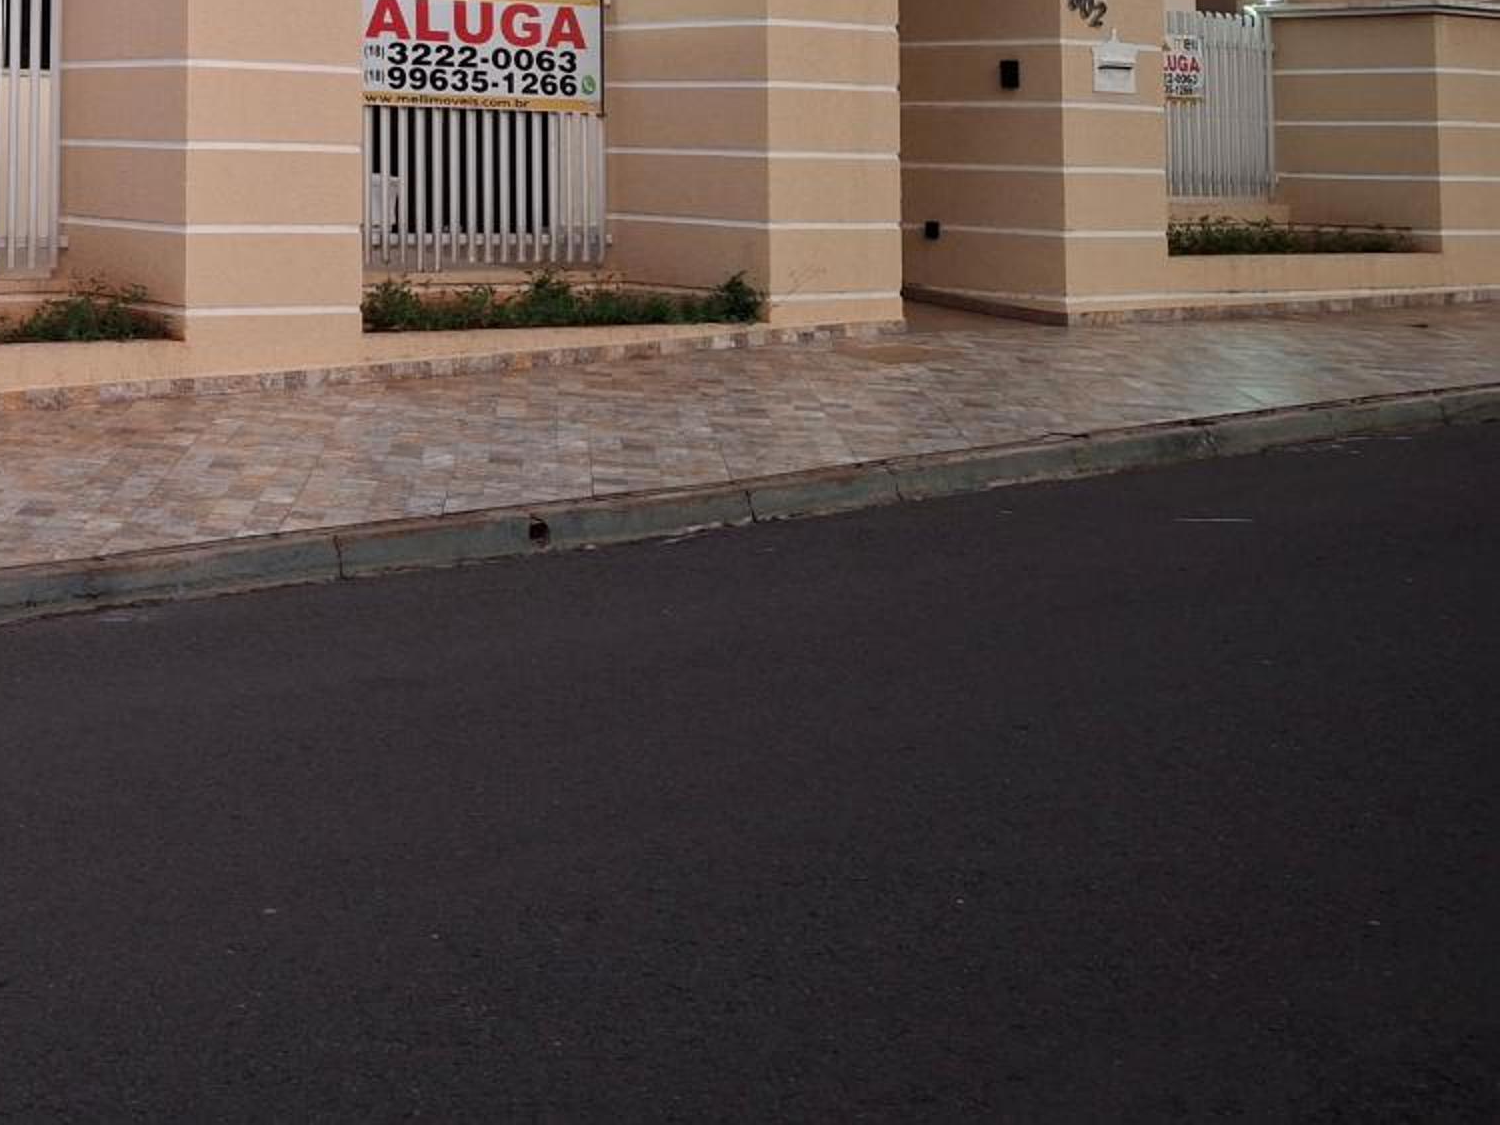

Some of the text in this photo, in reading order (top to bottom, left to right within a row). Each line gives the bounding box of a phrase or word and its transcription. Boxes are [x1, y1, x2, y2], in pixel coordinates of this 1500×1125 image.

[387, 42, 577, 73] 3222-0063
[1164, 54, 1200, 73] UGA
[387, 66, 577, 96] 99635-1266
